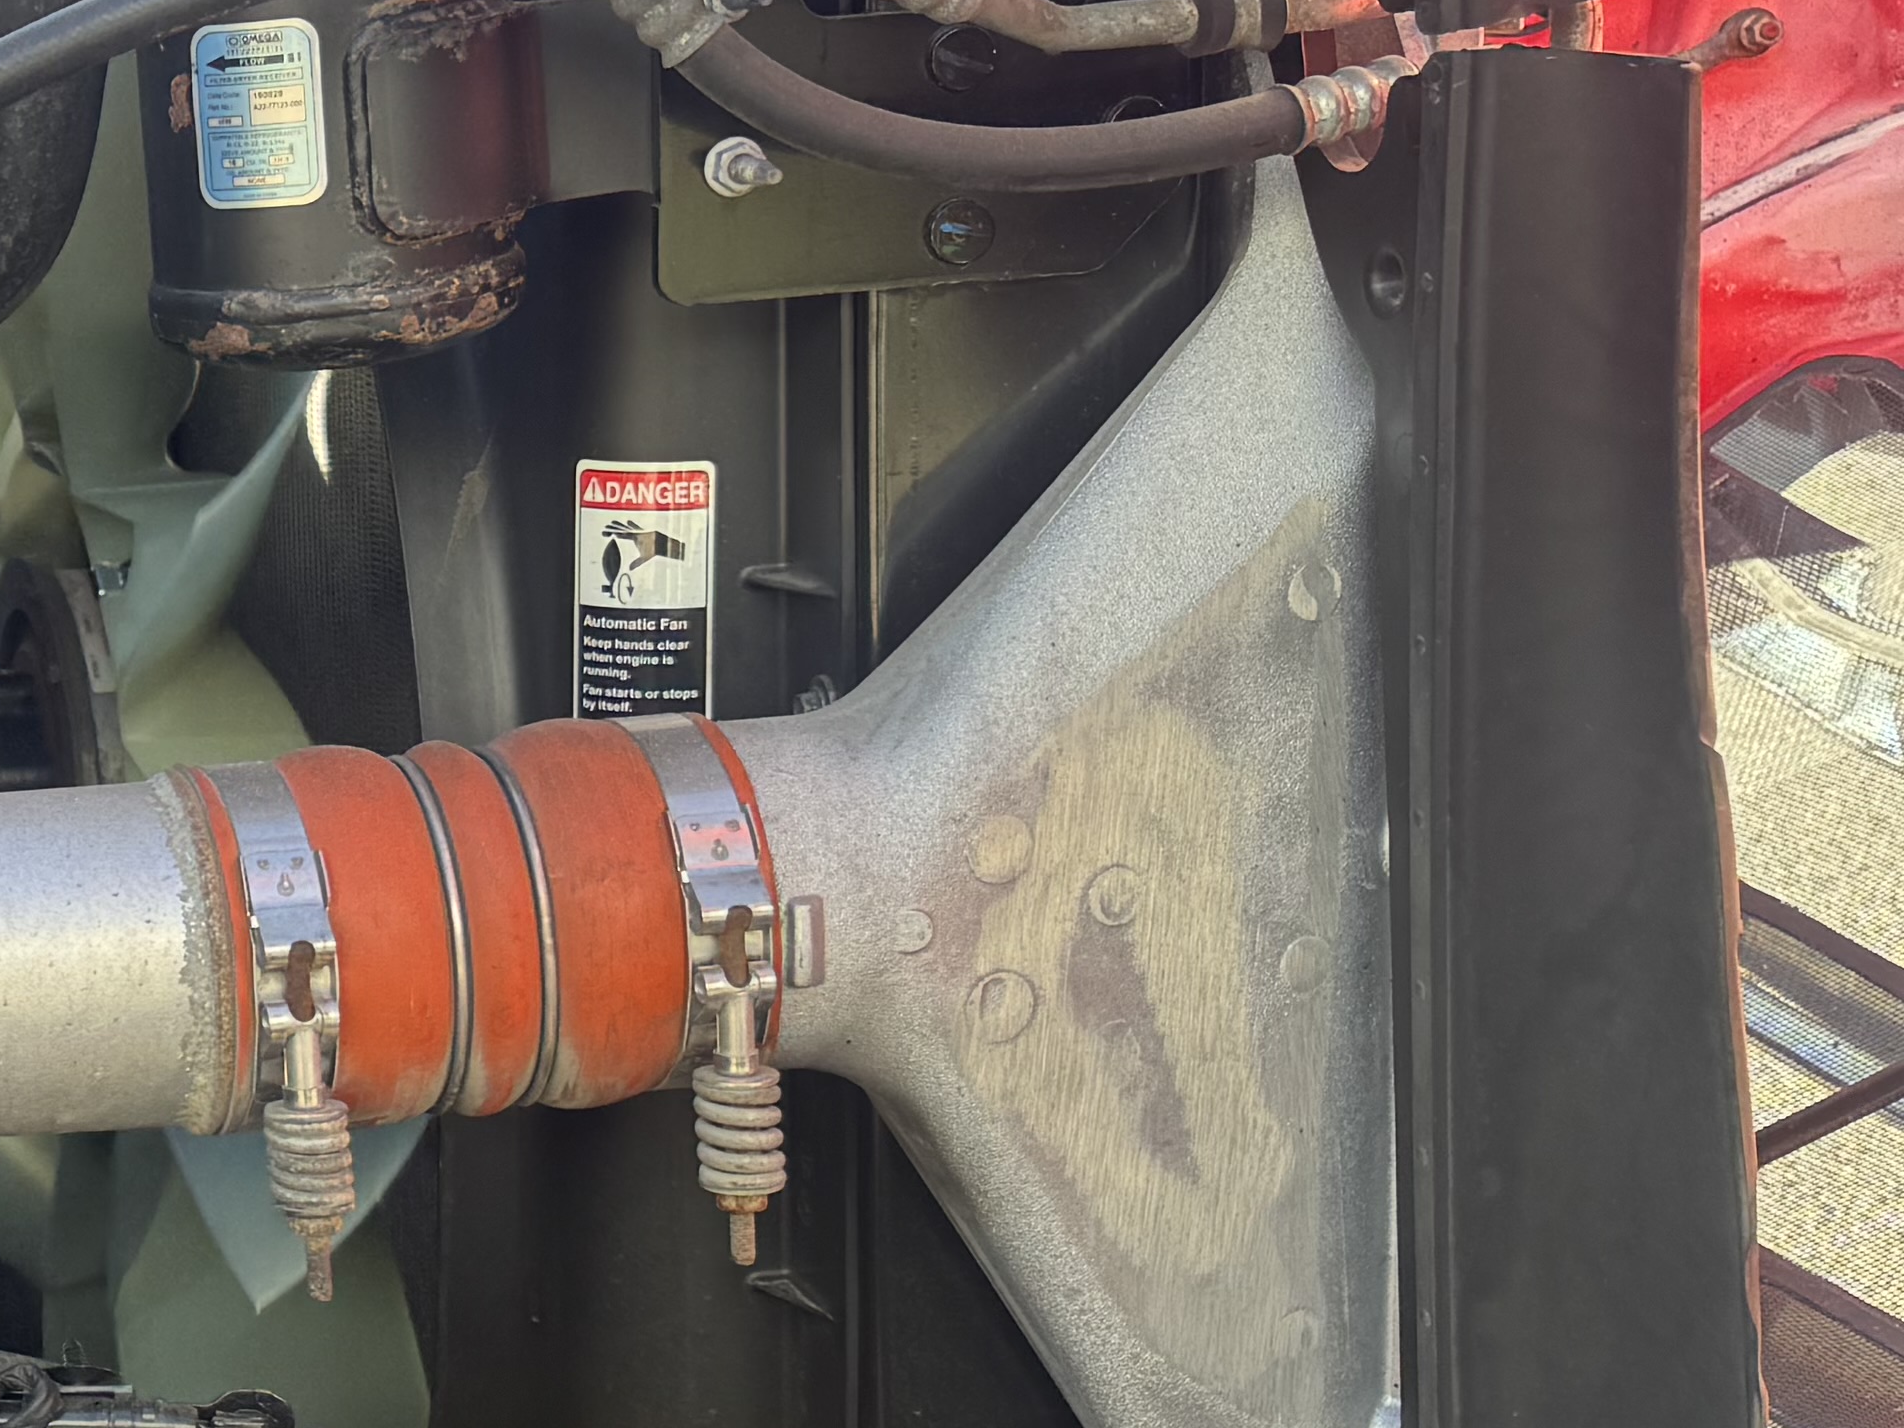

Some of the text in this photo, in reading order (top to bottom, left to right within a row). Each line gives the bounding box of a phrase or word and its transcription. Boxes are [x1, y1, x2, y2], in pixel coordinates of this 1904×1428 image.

[239, 58, 265, 66] FLOW
[606, 481, 705, 504] DANGER
[583, 615, 688, 631] Automatic Fan
[583, 635, 690, 651] Keep hands clear
[583, 652, 674, 667] when engine is
[583, 666, 632, 680] running.
[583, 684, 698, 701] Fan starts or stops
[583, 700, 633, 713] by itself.
